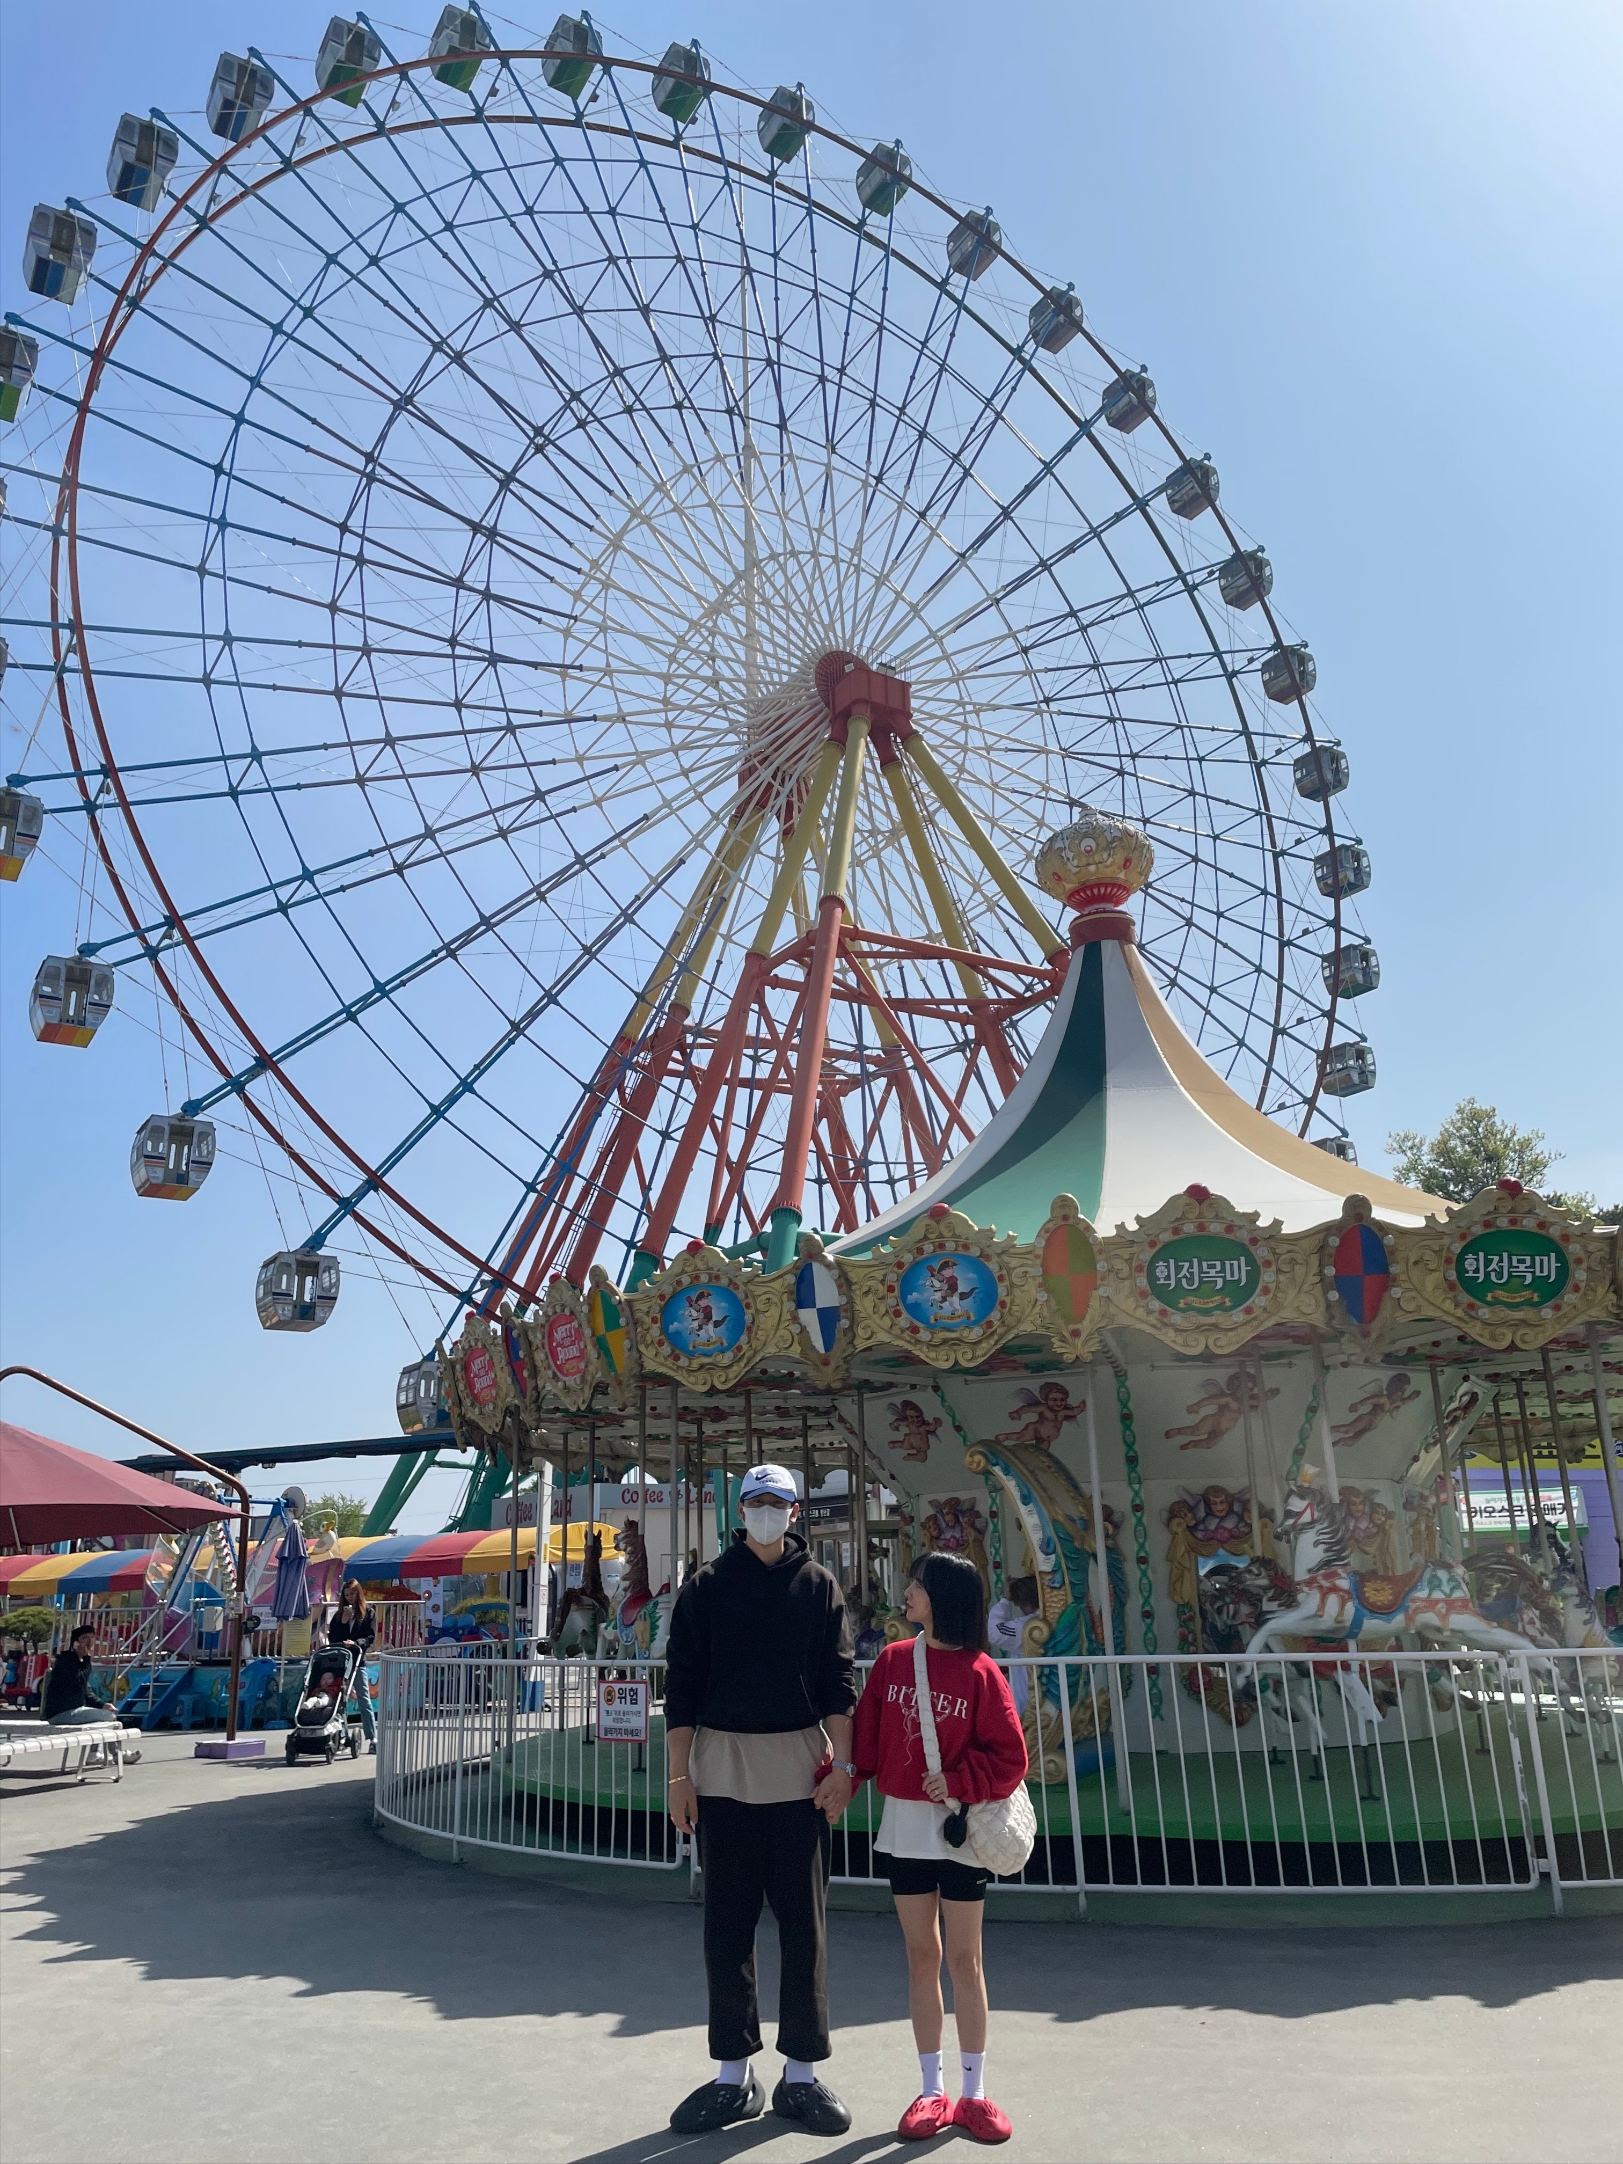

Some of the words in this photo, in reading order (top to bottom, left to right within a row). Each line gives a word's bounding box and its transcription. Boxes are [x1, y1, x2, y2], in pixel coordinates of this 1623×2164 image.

[1155, 1256, 1252, 1291] 회전목마
[1464, 1252, 1562, 1285] 회전목마
[553, 1323, 575, 1346] Merry
[556, 1340, 581, 1364] Round
[470, 1356, 488, 1377] Merry
[474, 1370, 493, 1394] Round
[621, 1488, 664, 1505] Cofee
[505, 1501, 533, 1526] Cffee
[617, 1687, 638, 1705] 위험
